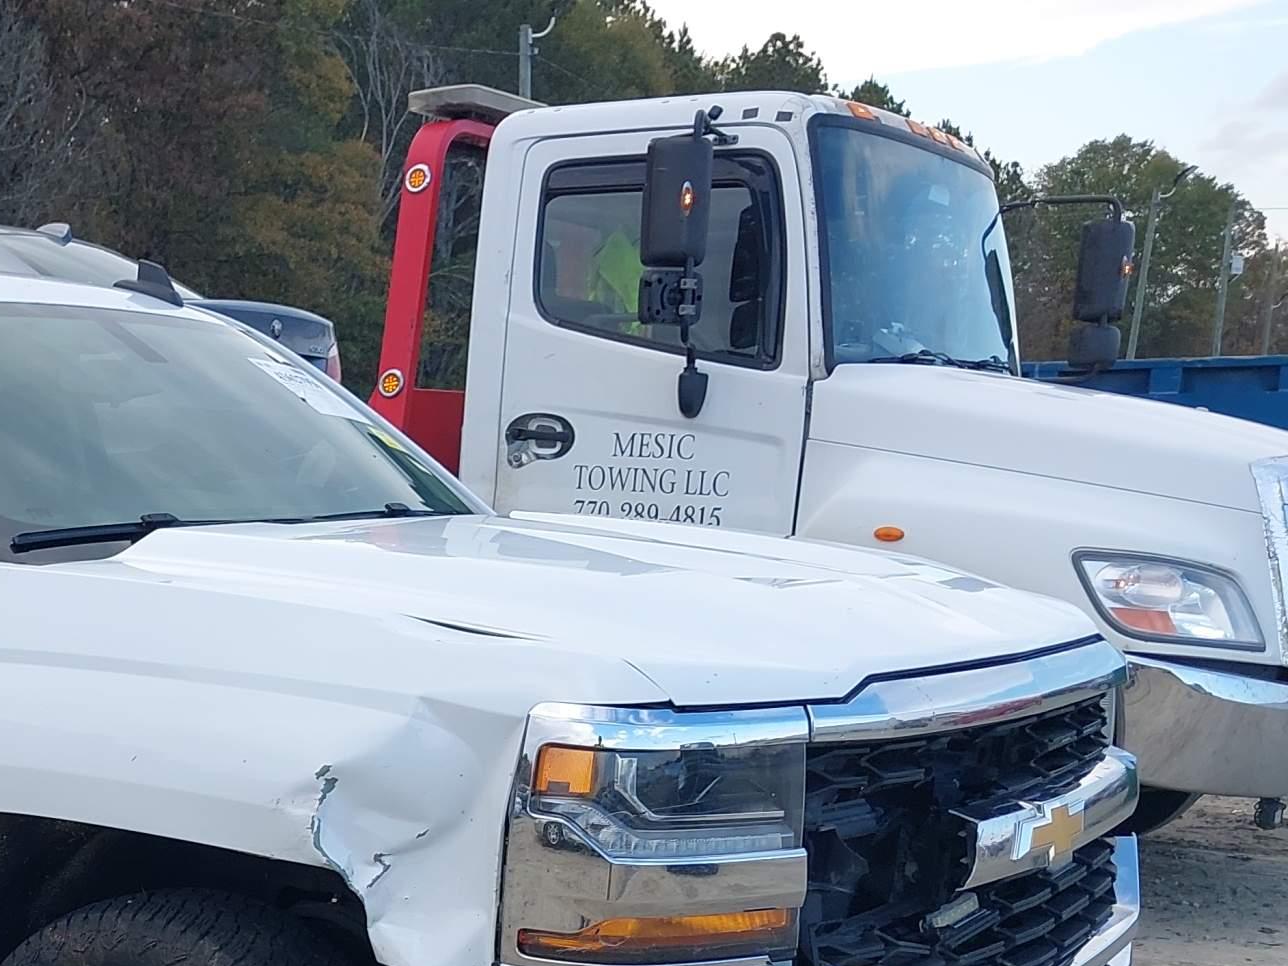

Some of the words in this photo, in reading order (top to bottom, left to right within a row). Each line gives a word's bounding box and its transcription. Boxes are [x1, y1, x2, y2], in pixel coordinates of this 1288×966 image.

[612, 432, 696, 460] MESIC
[574, 465, 677, 494] TOWING
[684, 470, 730, 497] LLC
